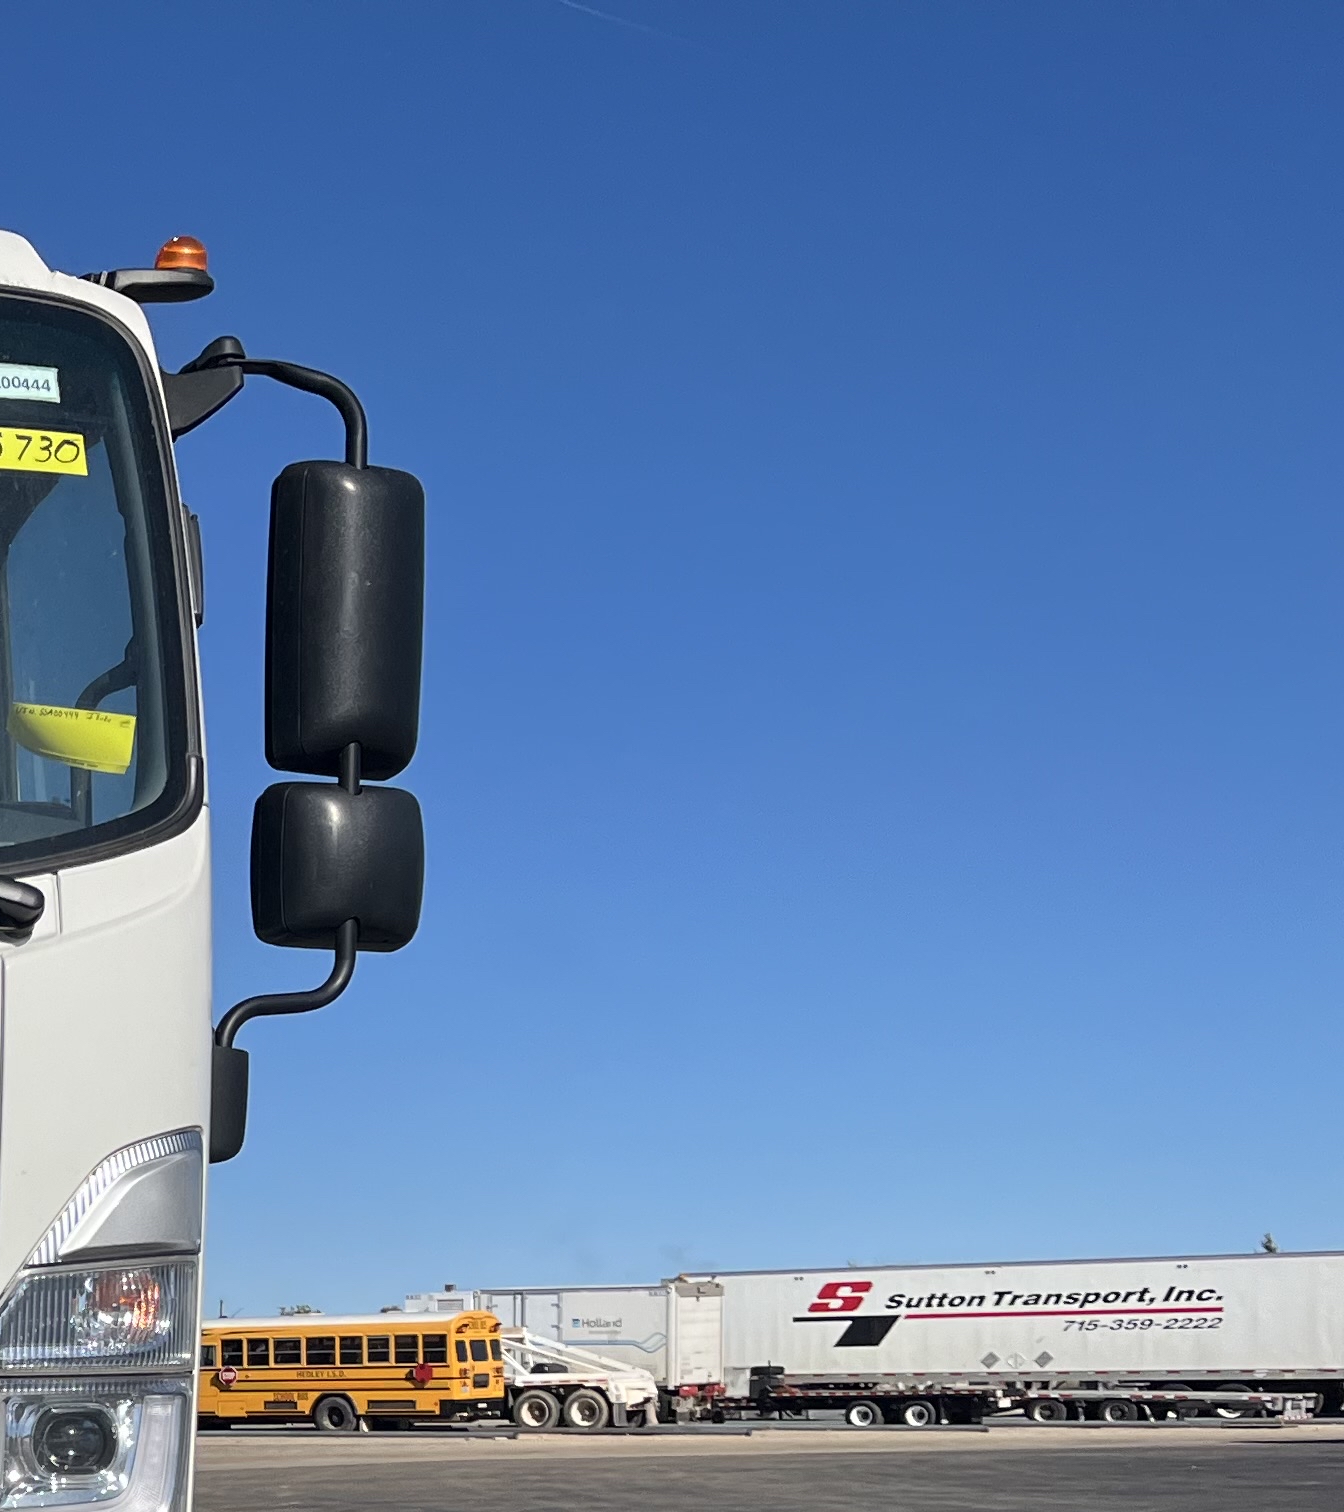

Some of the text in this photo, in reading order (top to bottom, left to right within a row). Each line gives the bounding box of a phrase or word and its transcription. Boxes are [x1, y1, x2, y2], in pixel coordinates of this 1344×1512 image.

[884, 1286, 1224, 1310] Sutton Transport, Inc.
[581, 1317, 623, 1328] Holland
[1062, 1317, 1224, 1332] 715-359-2222
